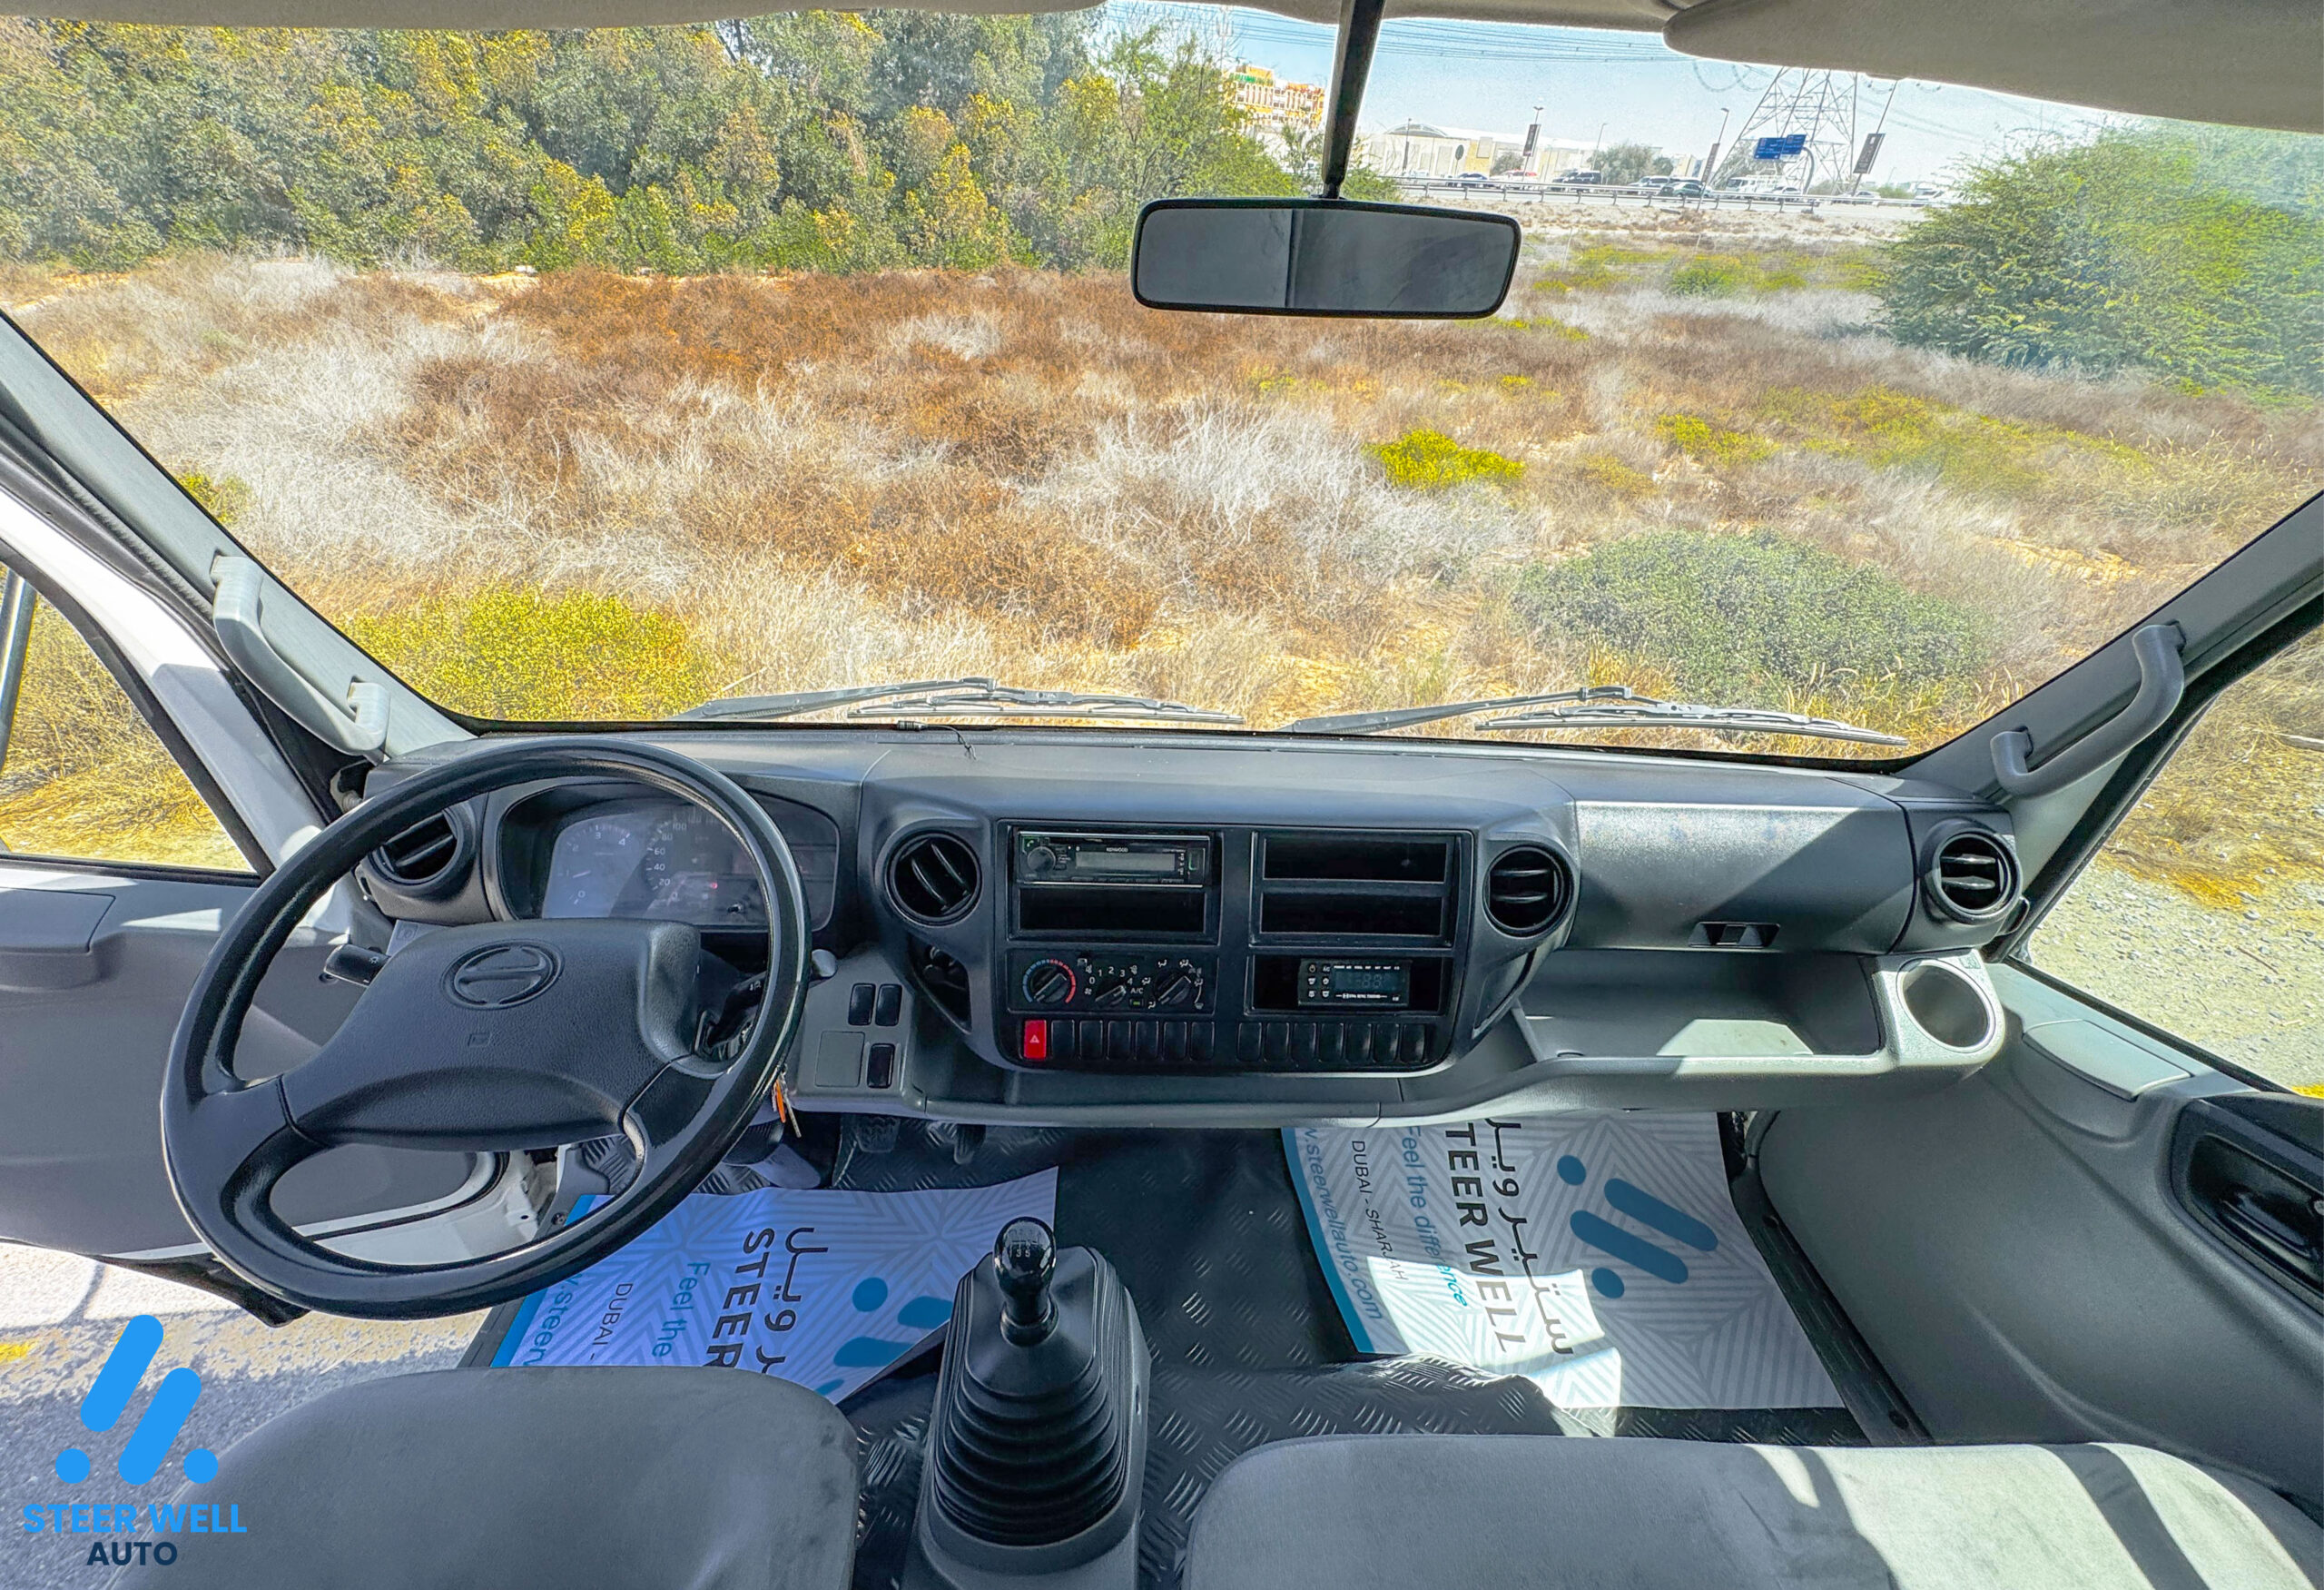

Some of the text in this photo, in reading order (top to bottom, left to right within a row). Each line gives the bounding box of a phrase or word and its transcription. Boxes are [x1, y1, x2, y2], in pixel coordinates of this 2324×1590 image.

[658, 878, 671, 886] 20
[1108, 966, 1115, 974] 2
[1119, 969, 1126, 977] 3
[1127, 977, 1133, 985] 4
[1304, 1125, 1384, 1319] w.steerwellauto.com
[1351, 1140, 1374, 1194] DUBAI
[1365, 1208, 1409, 1280] SHARJAH
[1406, 1170, 1430, 1209] the
[1444, 1121, 1526, 1354] TEER WELL
[703, 1227, 775, 1368] STEER
[1413, 1211, 1468, 1308] difference
[1498, 1207, 1573, 1355] ستير
[591, 1282, 634, 1346] DUBAI
[651, 1261, 712, 1358] Feel the
